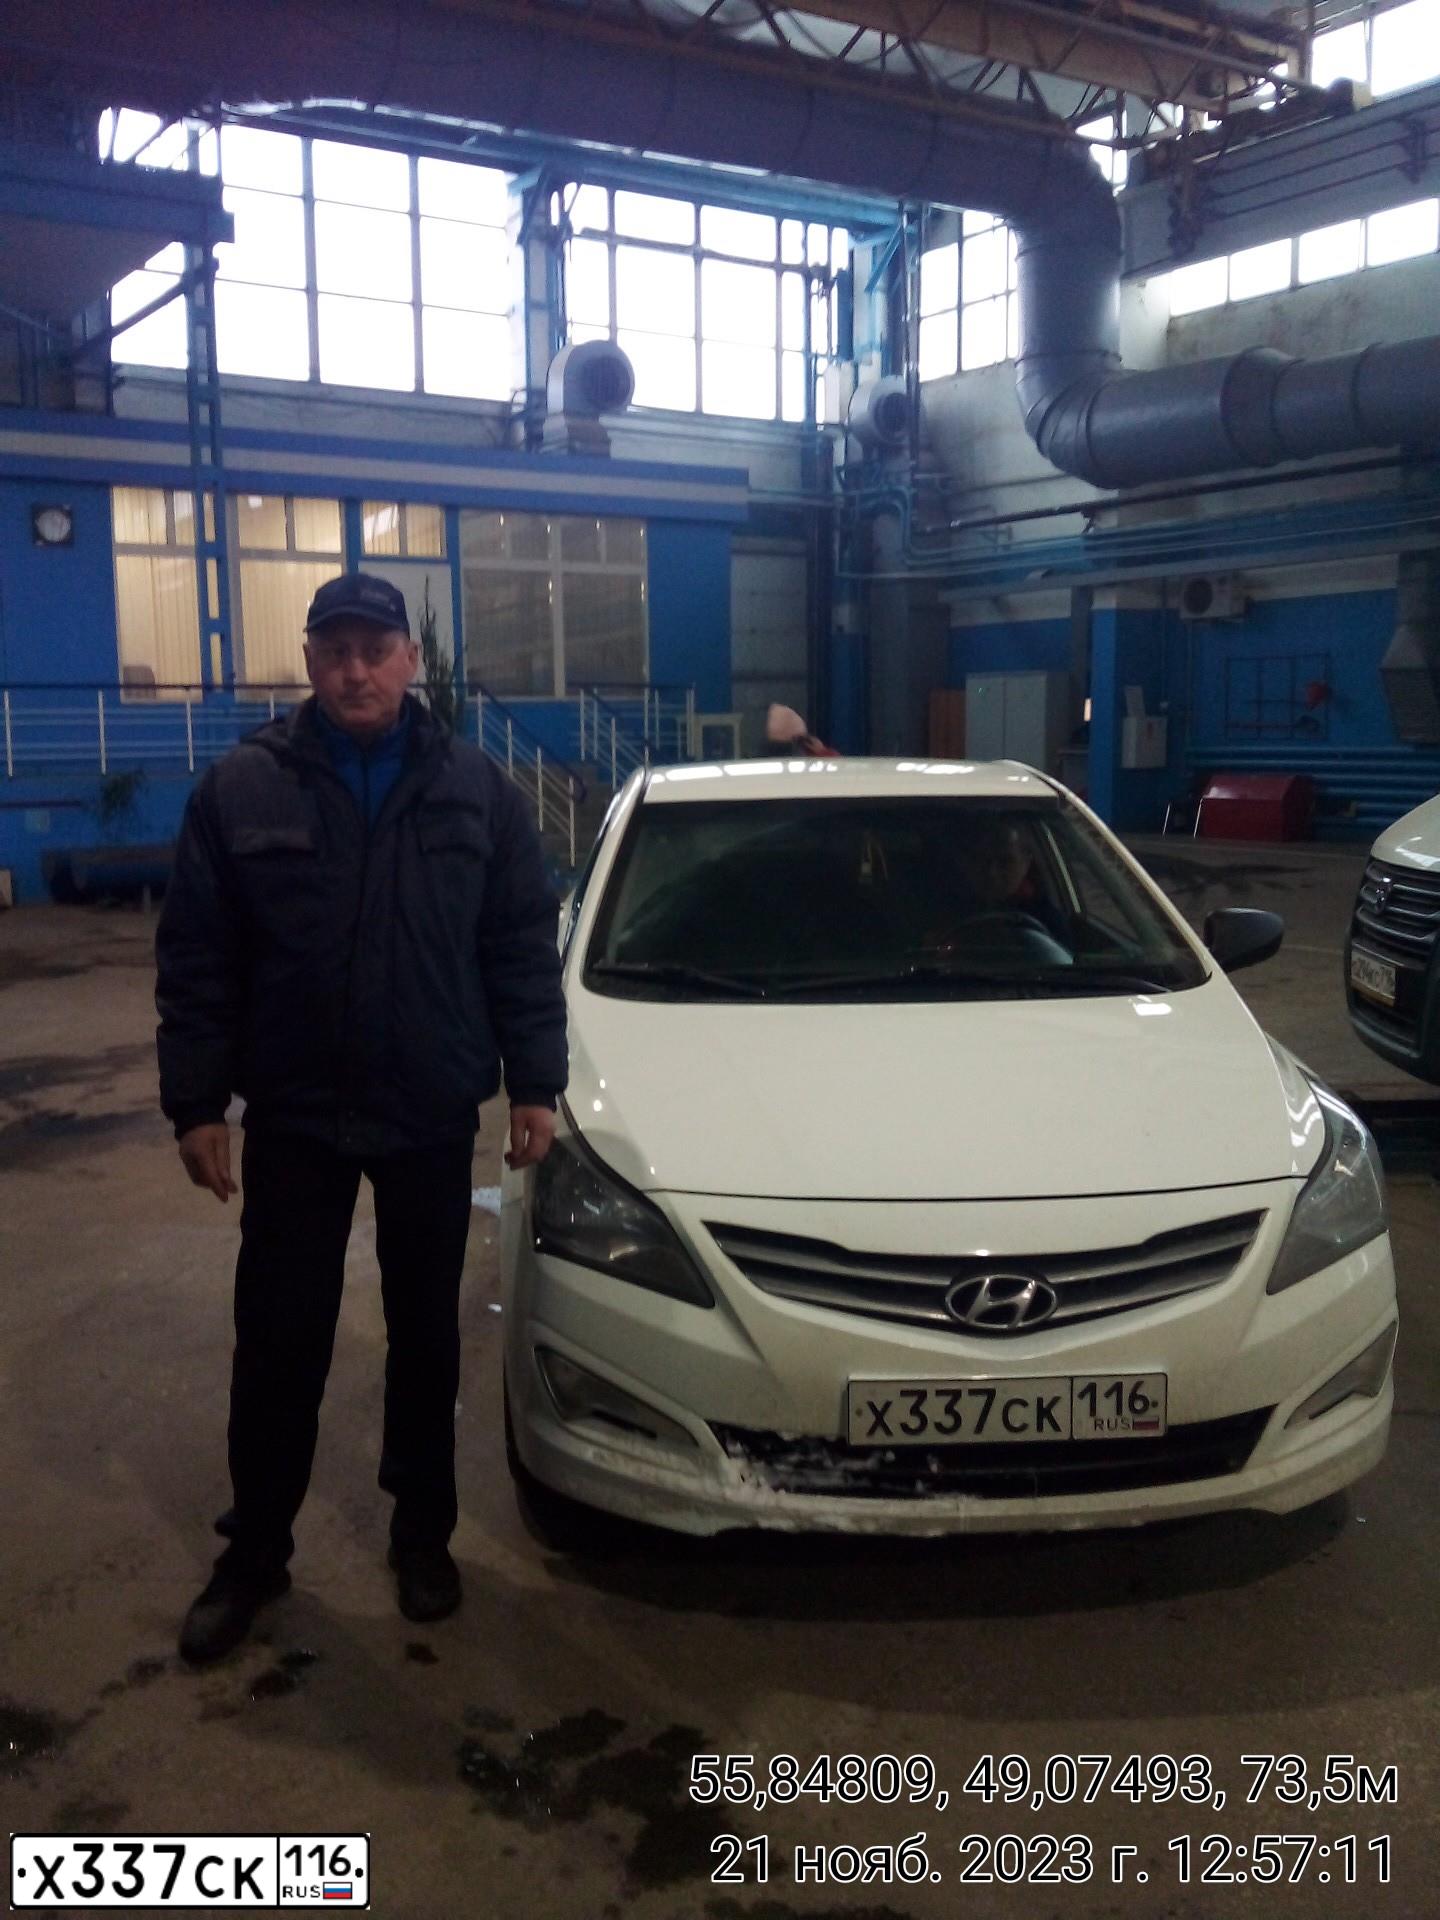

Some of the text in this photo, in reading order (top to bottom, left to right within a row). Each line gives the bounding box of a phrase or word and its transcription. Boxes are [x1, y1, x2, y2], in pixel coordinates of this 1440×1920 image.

[866, 1387, 1063, 1438] Х337СК
[1077, 1380, 1150, 1417] 116
[1094, 1417, 1131, 1431] RUS
